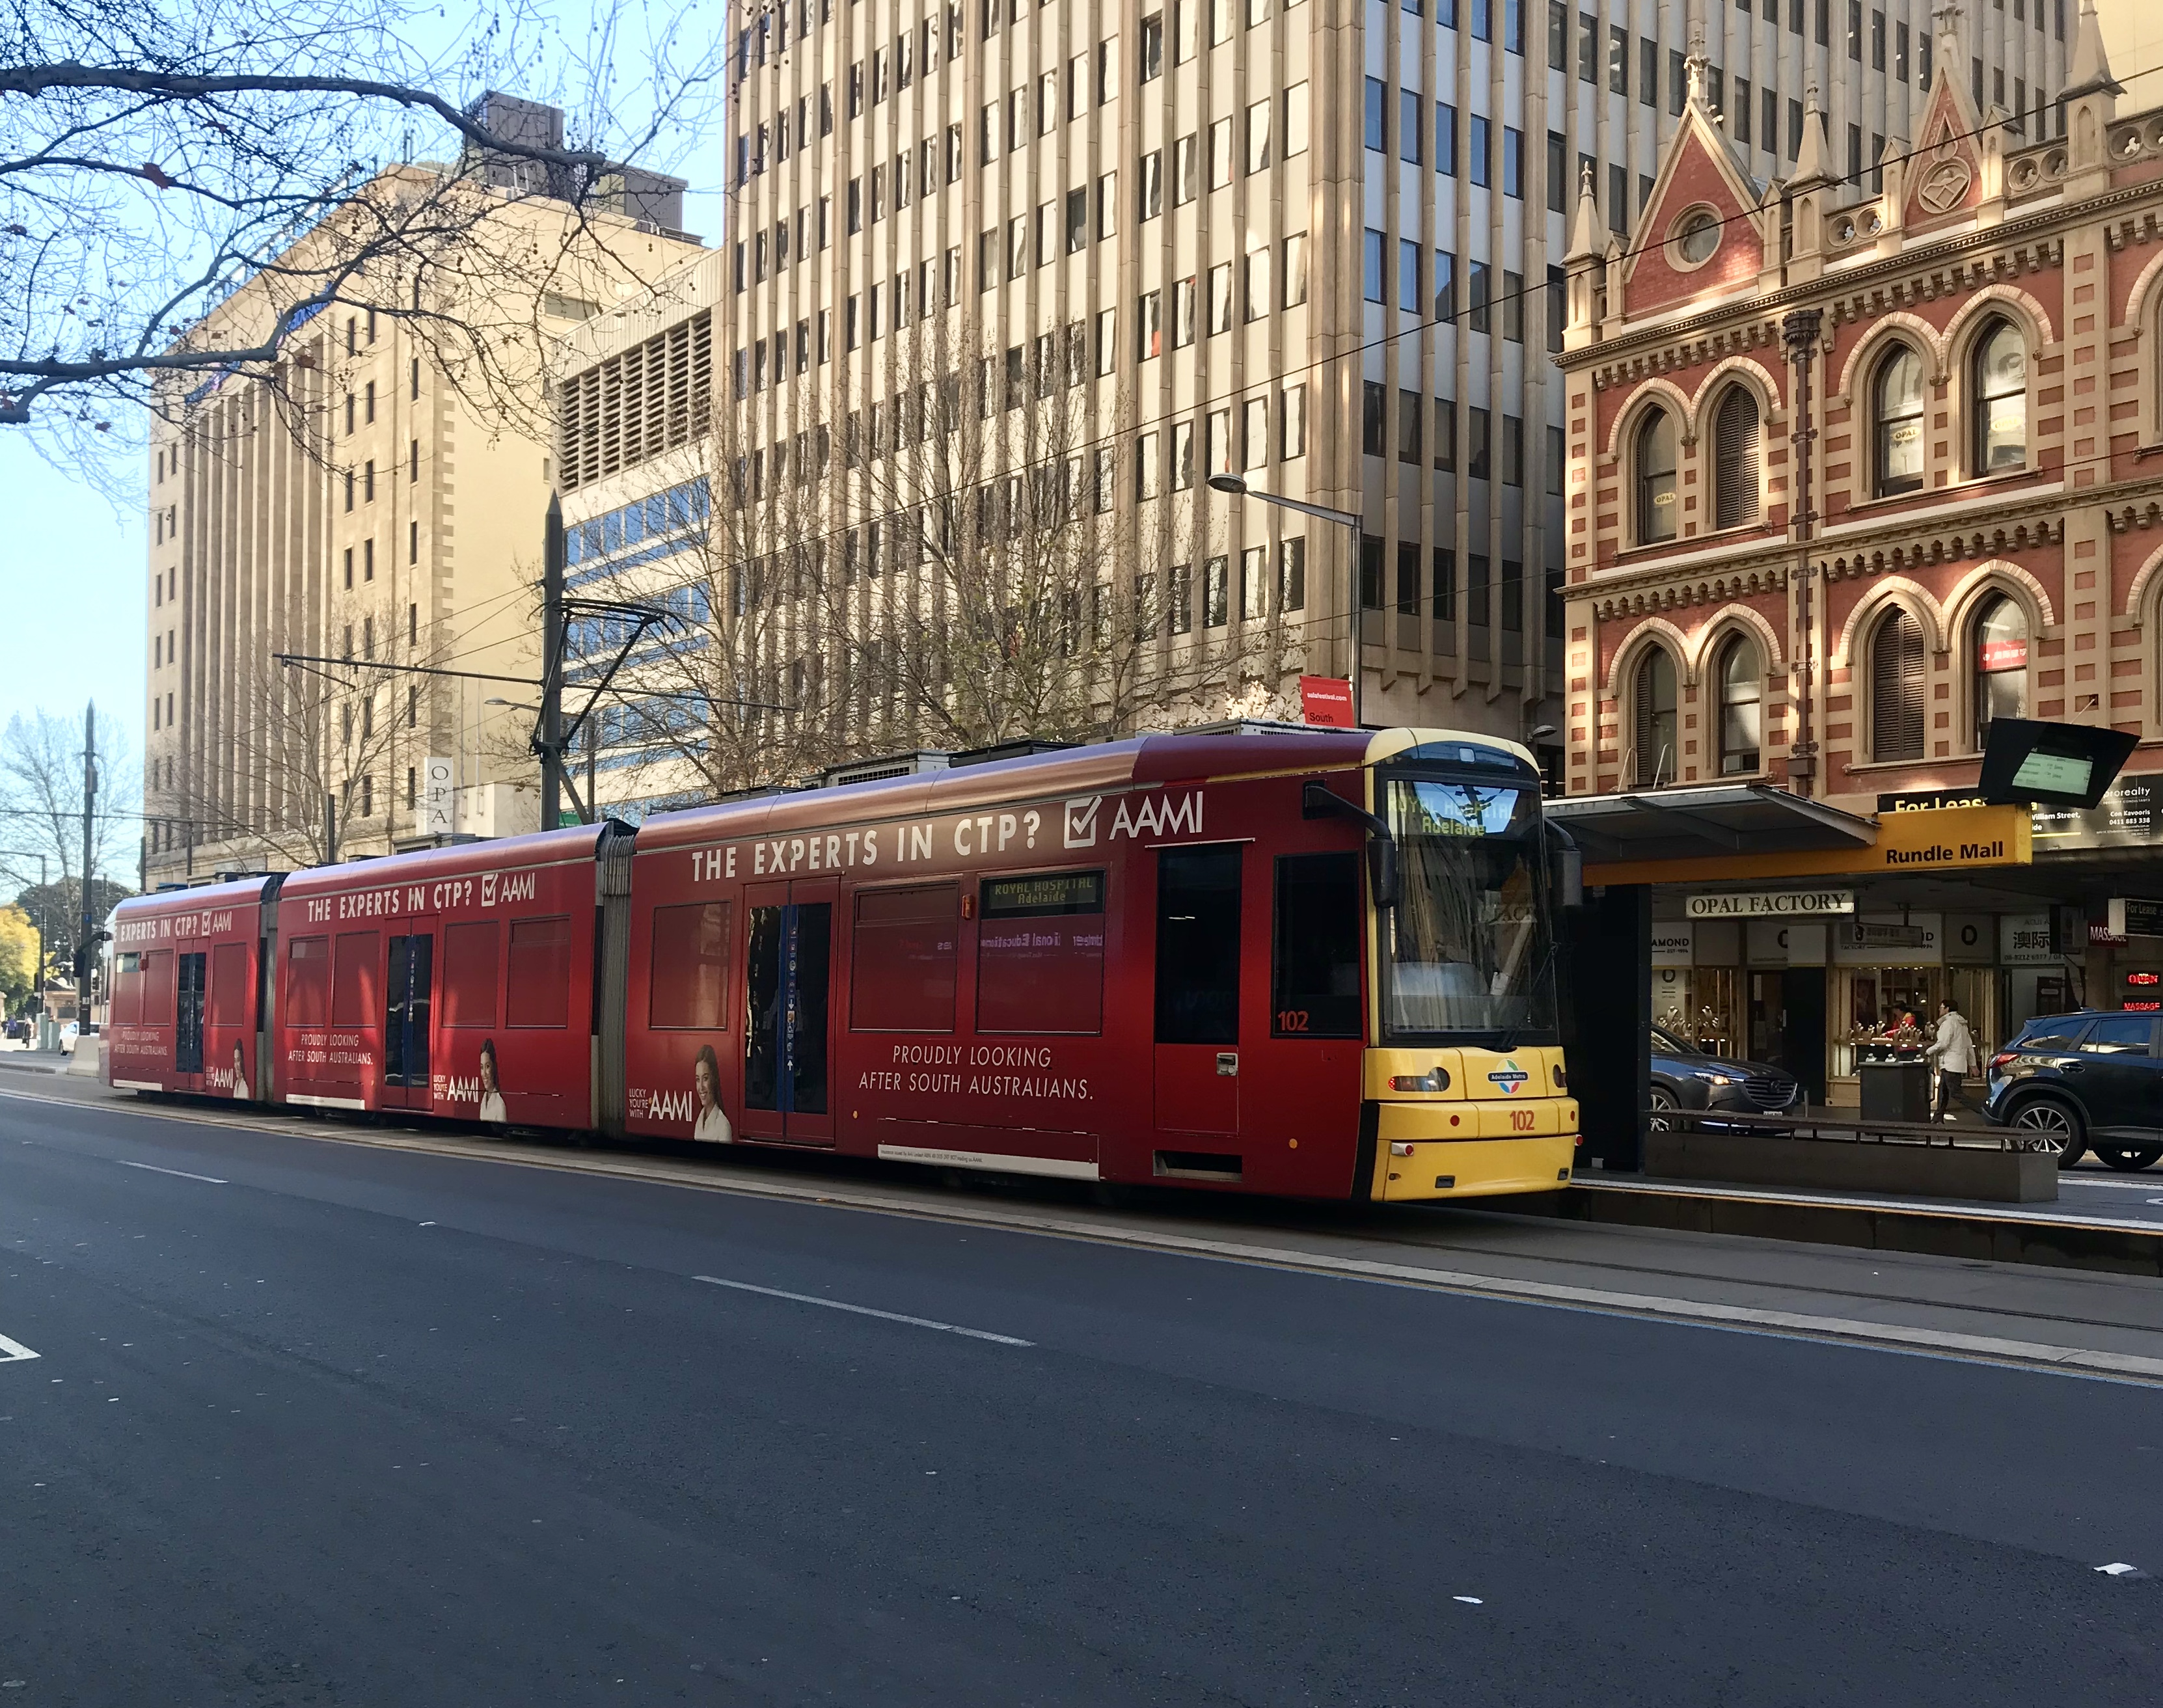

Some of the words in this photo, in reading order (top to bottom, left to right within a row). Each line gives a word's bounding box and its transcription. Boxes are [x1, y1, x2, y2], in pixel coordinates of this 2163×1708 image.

[1895, 430, 1916, 439] OPAL
[1309, 712, 1333, 722] South
[431, 766, 448, 828] OPA
[2102, 787, 2151, 799] prorealty
[1895, 800, 1929, 812] For
[2056, 811, 2081, 820] Street,
[692, 847, 737, 882] THE
[754, 830, 878, 875] EXPERTS
[897, 824, 932, 861] IN
[954, 810, 1041, 857] CTP?
[1109, 791, 1203, 841] AAMI
[1886, 845, 1952, 863] Rundle
[1960, 841, 2003, 859] Mall
[995, 882, 1030, 895] ROYAL
[1034, 877, 1093, 893] HOSPITAL
[308, 899, 331, 922] THE
[339, 889, 400, 919] EXPERTS
[408, 886, 425, 912] IN
[434, 880, 472, 907] CTP?
[500, 872, 535, 902] AAMI
[1018, 891, 1066, 904] Adelaide
[1692, 897, 1743, 915] OPAL
[1748, 893, 1846, 912] FACTORY
[2127, 902, 2138, 914] For
[2139, 903, 2157, 915] Lease
[121, 920, 156, 942] EXPERTS
[160, 919, 170, 938] IN
[175, 915, 198, 936] CTP?
[212, 911, 232, 932] AAMI
[2013, 931, 2050, 949] 澳际
[2124, 1002, 2160, 1011] MASSAGE
[1277, 1011, 1309, 1031] 102
[301, 1034, 327, 1046] PROUDLY
[330, 1034, 359, 1046] LOOKING
[288, 1050, 305, 1061] AFTER
[307, 1051, 327, 1063] SOUTH
[329, 1051, 373, 1064] AUSTRALIANS.
[893, 1045, 962, 1064] PROUDLY
[970, 1046, 1052, 1068] LOOKING
[213, 1067, 234, 1089] AAMI
[859, 1072, 901, 1091] AFTER
[909, 1073, 960, 1093] SOUTH
[969, 1076, 1094, 1100] AUSTRALIANS.
[447, 1075, 479, 1103] AAMI
[629, 1088, 647, 1098] LUCKY
[629, 1098, 649, 1109] YOU'RE
[648, 1089, 692, 1122] AAMI
[629, 1109, 644, 1118] WITH
[1510, 1110, 1535, 1131] 102
